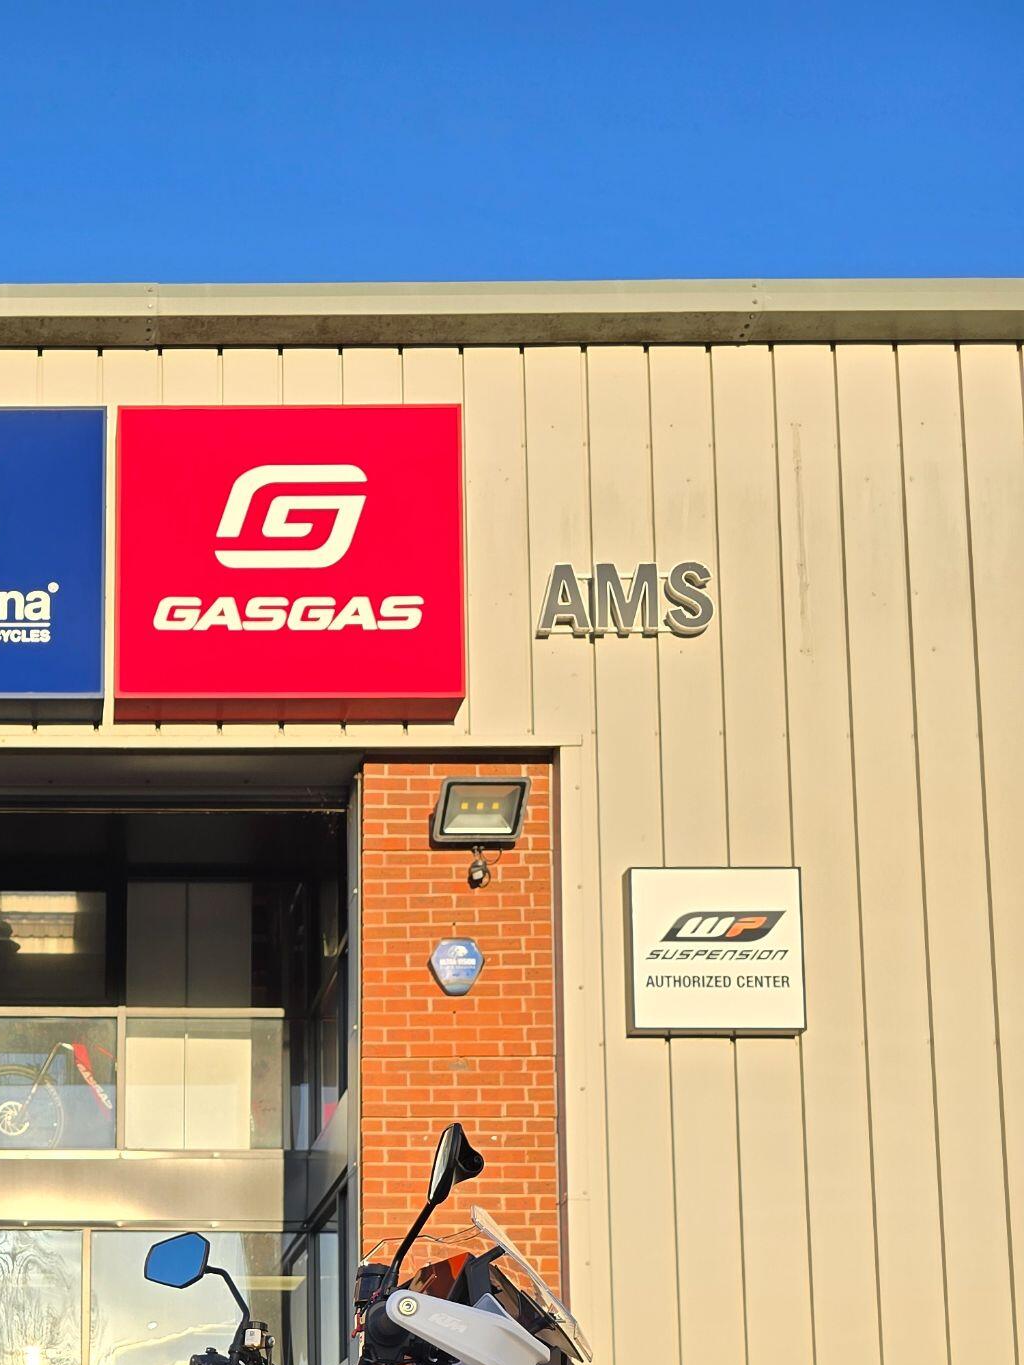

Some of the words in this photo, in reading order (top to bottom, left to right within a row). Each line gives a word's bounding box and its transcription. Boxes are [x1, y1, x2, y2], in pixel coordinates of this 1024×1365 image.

[536, 561, 715, 638] AMS
[152, 595, 425, 631] GASGAS
[645, 949, 790, 961] SUSPENSION
[646, 975, 732, 989] AUTHORIZED
[736, 975, 791, 989] CENTER
